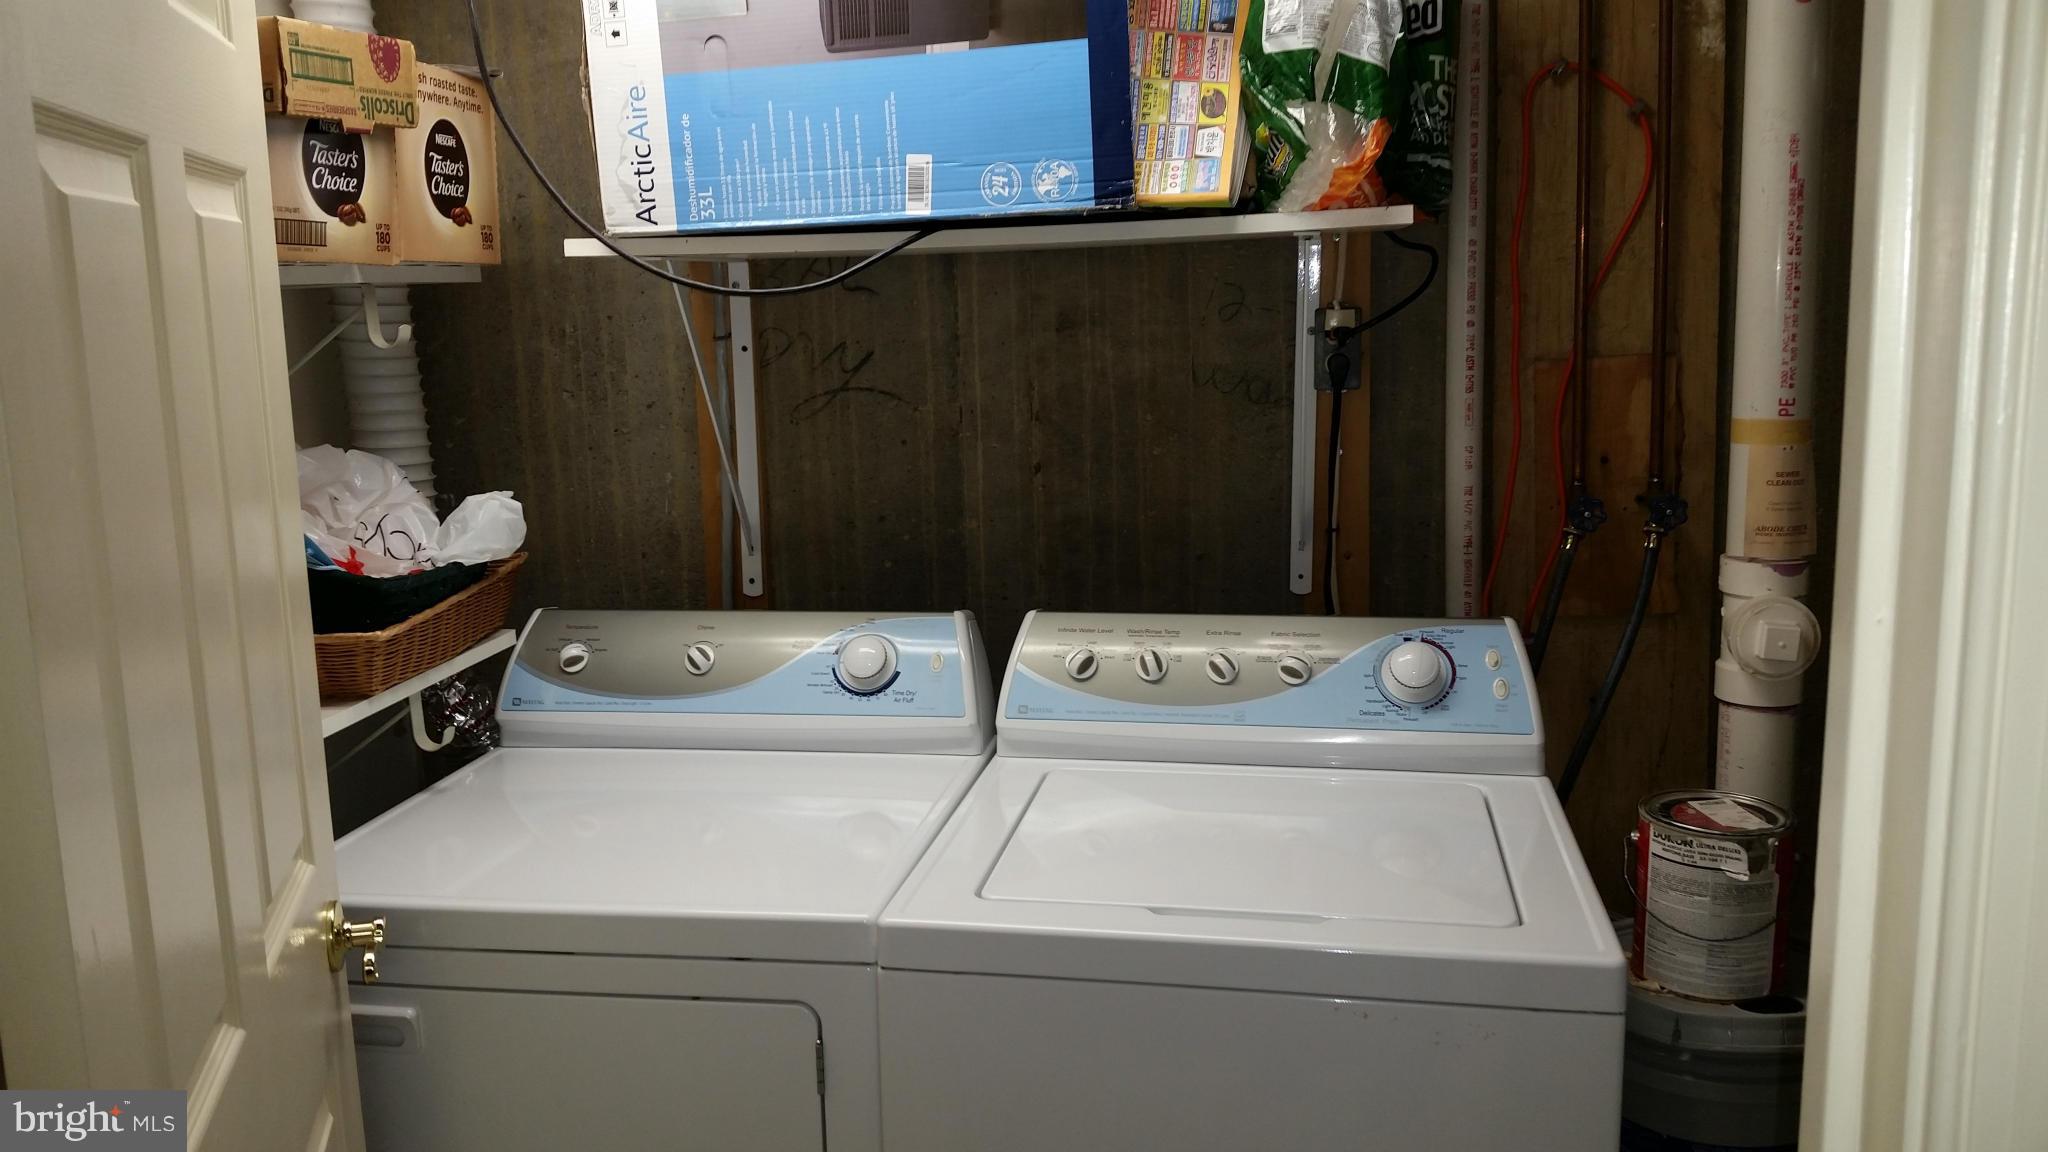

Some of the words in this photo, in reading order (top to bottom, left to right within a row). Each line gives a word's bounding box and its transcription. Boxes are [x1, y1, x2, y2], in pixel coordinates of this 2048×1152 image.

[429, 77, 457, 92] roasted
[458, 83, 478, 98] taste.
[359, 95, 415, 125] Driscoll's
[453, 97, 484, 115] Anytime.
[681, 113, 690, 127] de
[309, 140, 359, 169] Taster's
[428, 152, 464, 177] Taster's
[626, 85, 658, 226] ArcticAire
[311, 167, 358, 192] Choice
[682, 130, 698, 222] Deshumidificador
[431, 176, 464, 197] Choice
[698, 186, 716, 220] 33L
[375, 223, 383, 231] UP
[375, 231, 391, 244] 180
[480, 231, 493, 244] 180
[376, 244, 391, 253] CUPS
[1778, 397, 1797, 417] PE
[1441, 627, 1465, 636] Regular
[892, 689, 905, 697] Time
[1359, 709, 1386, 717] Delicates
